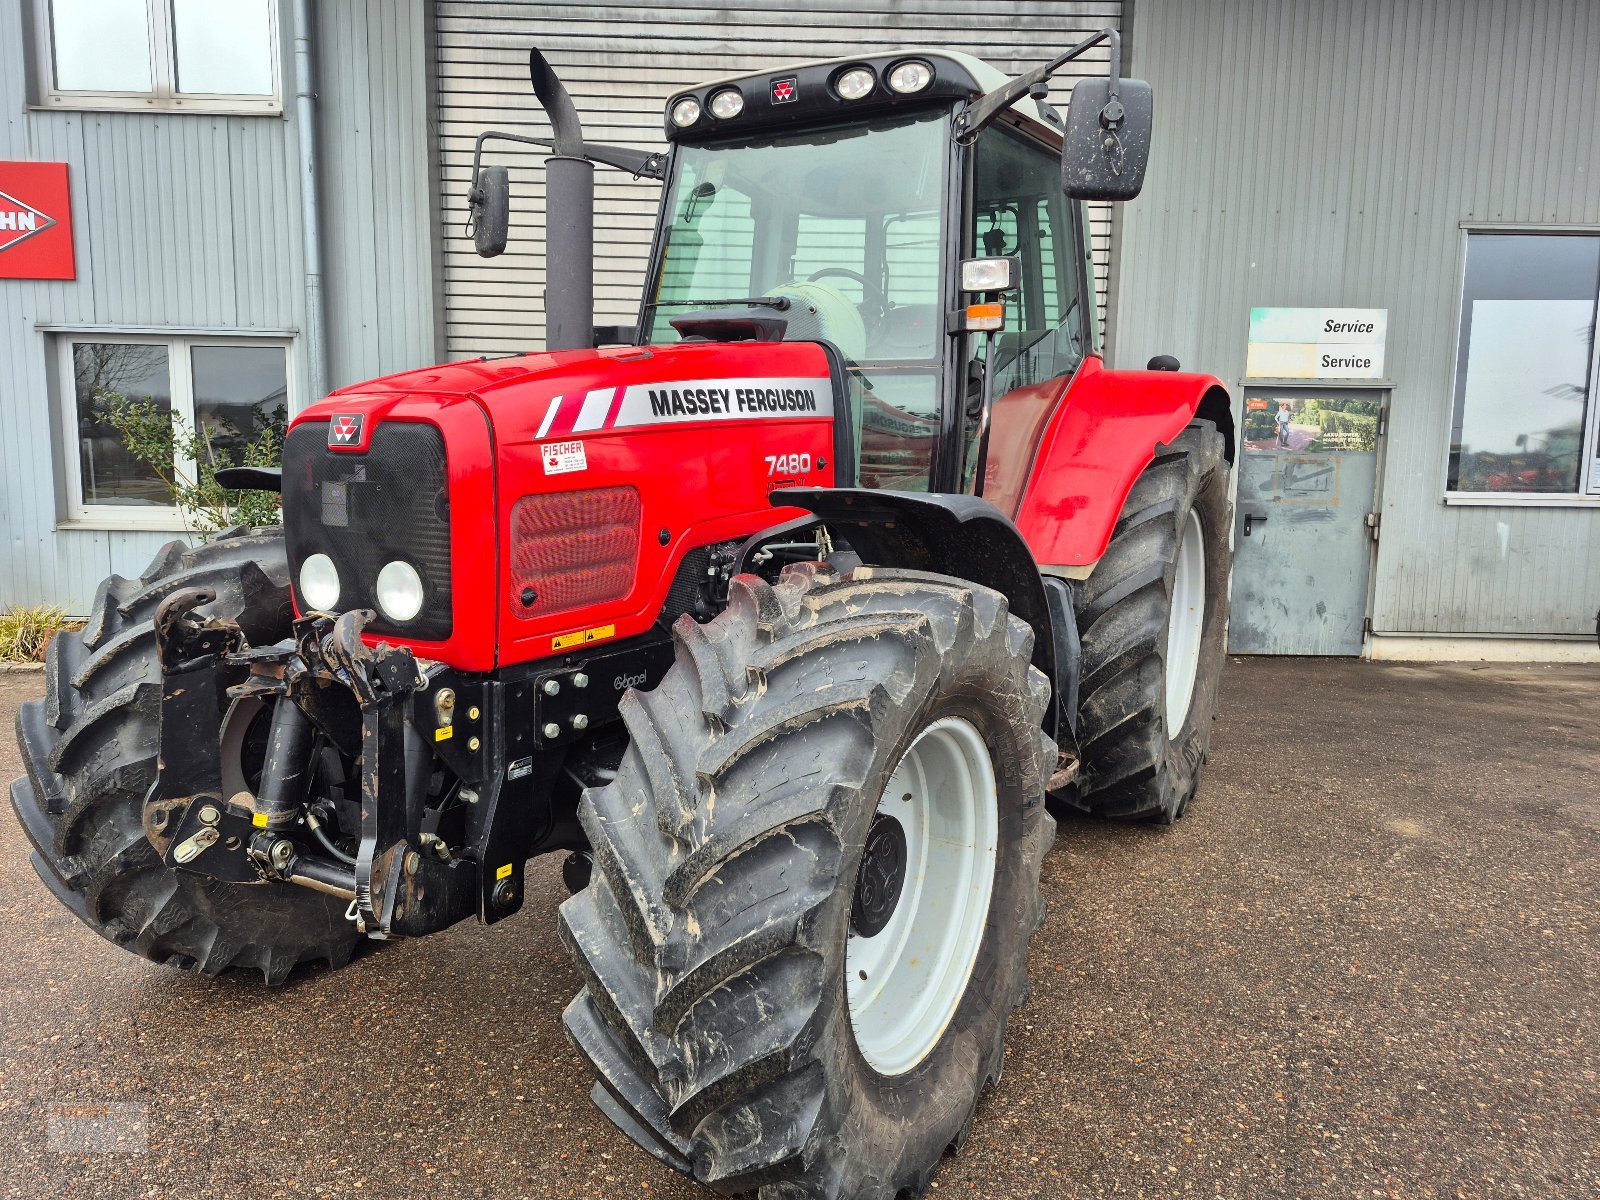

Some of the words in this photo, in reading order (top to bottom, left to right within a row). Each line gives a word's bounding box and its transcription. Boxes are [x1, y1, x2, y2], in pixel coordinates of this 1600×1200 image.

[1323, 319, 1374, 333] Service
[1321, 354, 1371, 368] Service
[648, 388, 731, 417] MASSEY
[735, 388, 817, 413] FERGUSON
[543, 442, 582, 457] FISCHER
[765, 453, 811, 476] 7480
